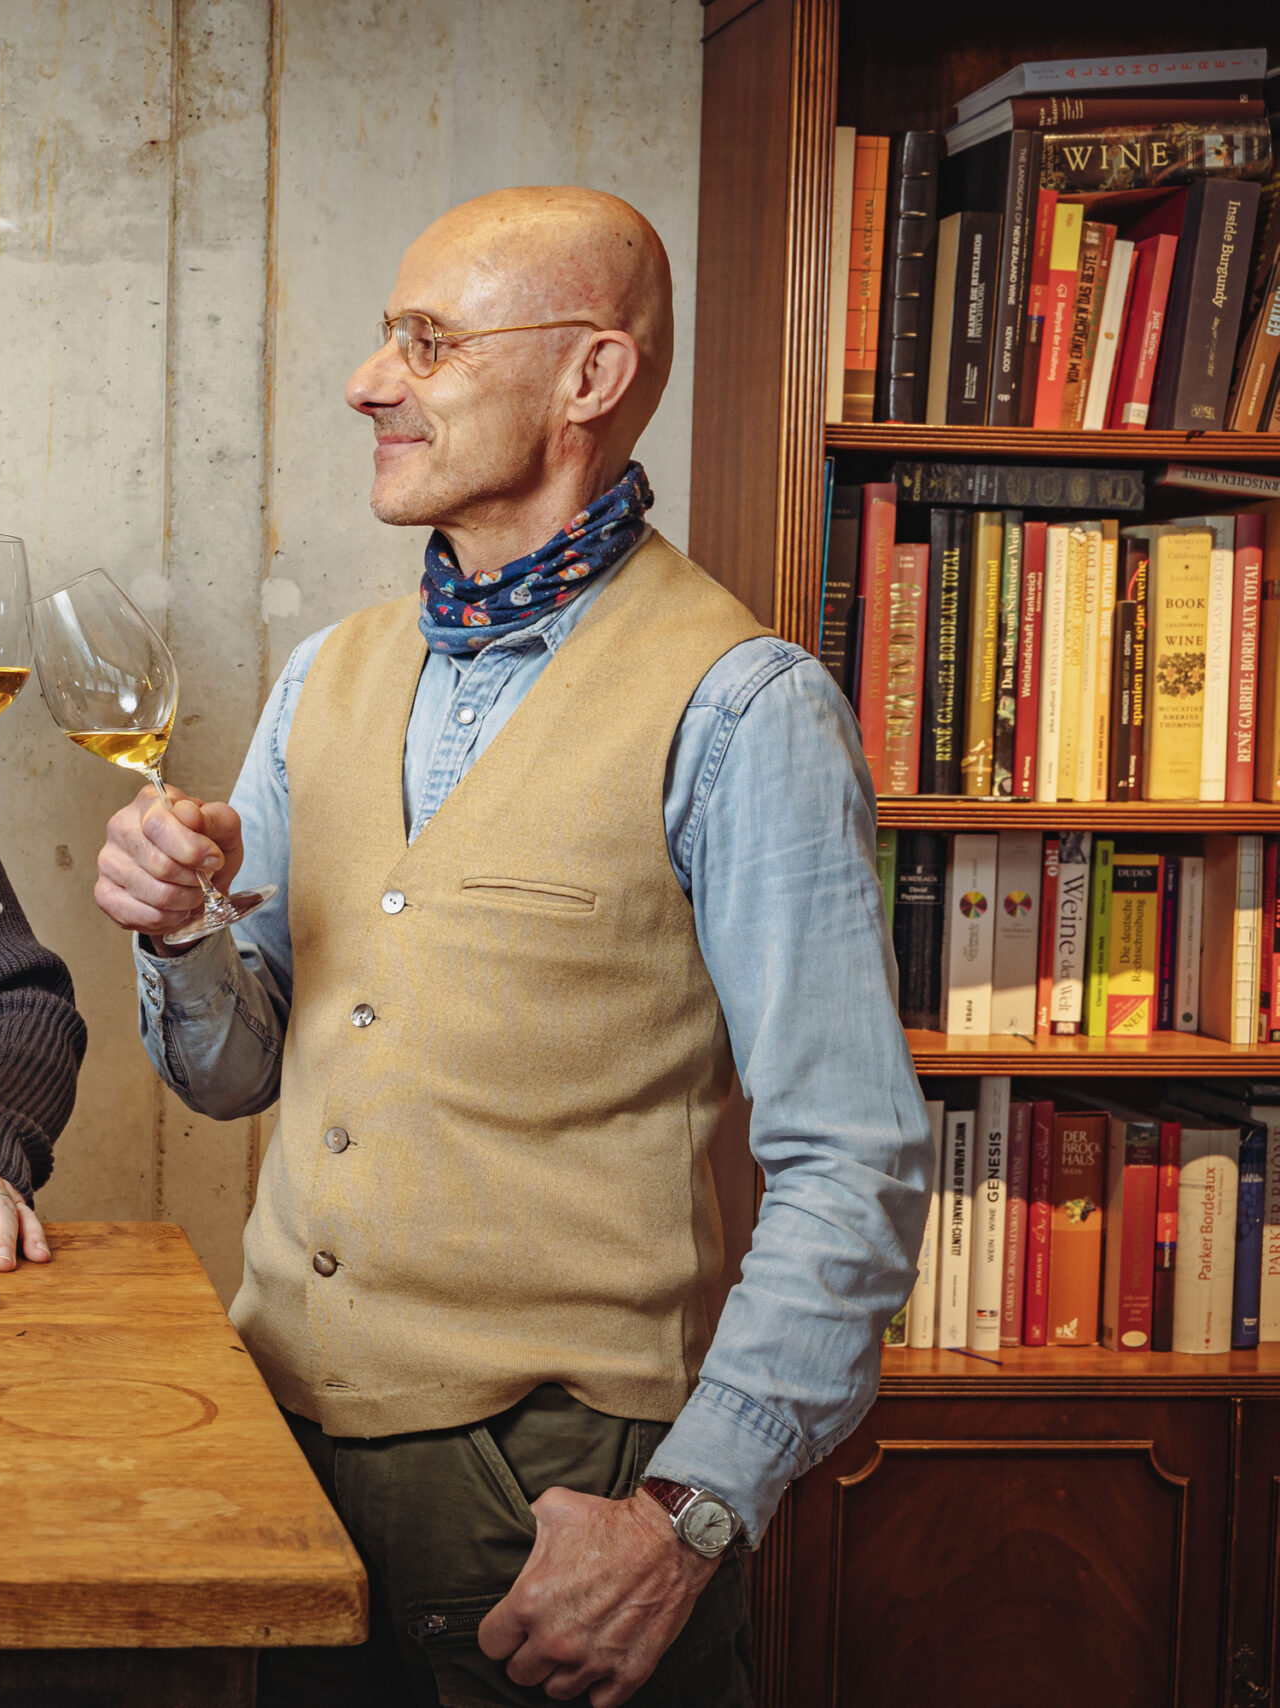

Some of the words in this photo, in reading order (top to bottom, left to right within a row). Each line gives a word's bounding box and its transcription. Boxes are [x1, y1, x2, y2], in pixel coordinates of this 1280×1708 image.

[1065, 60, 1242, 79] ALKOHOLFREI
[1020, 148, 1028, 164] THE
[1062, 142, 1170, 171] WINE
[1017, 165, 1027, 213] LANDSCAPE
[863, 199, 875, 253] KITCHEN
[1013, 226, 1022, 244] NEW
[1223, 200, 1241, 241] Inside
[971, 234, 983, 285] RETALHOS
[1010, 246, 1020, 283] ZEALAND
[1083, 253, 1098, 283] BESTE
[1212, 244, 1234, 309] Burgundy
[970, 287, 979, 301] DE
[1008, 284, 1017, 305] WINE
[1082, 284, 1092, 306] DAS
[967, 302, 978, 337] MANTA
[1054, 302, 1066, 332] Biophysik
[1071, 307, 1089, 361] EINFACHEN
[1005, 326, 1014, 349] KEVIN
[1053, 334, 1061, 345] der
[1003, 351, 1012, 373] JUDD
[1047, 346, 1061, 382] Ernährung
[1067, 362, 1079, 383] VOM
[1181, 468, 1219, 483] WEINE
[876, 527, 889, 575] WEINE
[1008, 527, 1020, 555] Wein
[942, 547, 960, 588] TOTAL
[1055, 540, 1064, 585] SPANIEN
[1101, 544, 1115, 607] AUSTRALIAN
[984, 559, 998, 639] Deutschland
[1006, 558, 1018, 612] Schweizer
[1025, 571, 1036, 621] Frankreich
[1137, 560, 1147, 603] weine
[1244, 563, 1259, 604] TOTAL
[872, 579, 885, 632] GROSSE
[1165, 598, 1206, 609] BOOK
[887, 582, 923, 690] CALIFORNIA
[939, 592, 957, 662] BORDEAUX
[1006, 613, 1015, 637] vom
[1049, 590, 1062, 688] WEINLANDSCHAFT
[1100, 609, 1113, 636] WINE
[1135, 604, 1145, 641] seine
[1241, 606, 1257, 672] BORDEAUX
[1003, 638, 1014, 667] Buch
[1135, 644, 1144, 671] und
[1165, 636, 1204, 646] WINE
[1211, 604, 1224, 682] WEINATLAS
[869, 637, 882, 699] ITALIENS
[980, 641, 994, 703] Weinatlas
[1001, 668, 1013, 689] Das
[1021, 624, 1034, 698] Weinlandschaft
[1132, 674, 1144, 727] spanien
[1238, 673, 1254, 729] GABRIEL:
[932, 728, 952, 762] RENÉ
[1233, 732, 1252, 763] RENÉ
[1046, 850, 1059, 877] oh!
[1118, 869, 1152, 877] DUDEN
[1059, 874, 1085, 955] Weine
[1121, 898, 1133, 943] deutsche
[1120, 946, 1130, 964] Die
[1131, 898, 1146, 982] Rechtschreibung
[1060, 959, 1075, 979] der
[1058, 984, 1073, 1011] Welt
[1123, 1008, 1145, 1032] NEU
[956, 1122, 967, 1148] WHO'S
[1063, 1131, 1087, 1142] DER
[1063, 1142, 1101, 1153] BROCK
[954, 1149, 966, 1176] AFRAID
[987, 1131, 1002, 1203] GENESIS
[1062, 1153, 1095, 1165] HAUS
[954, 1177, 964, 1187] OF
[1200, 1168, 1217, 1235] Bordeaux
[988, 1208, 996, 1232] WINE
[1010, 1205, 1019, 1243] LEXIKON
[987, 1239, 995, 1263] WEIN
[1268, 1203, 1280, 1276] PARKER
[1007, 1245, 1017, 1282] GROSSES
[1198, 1238, 1212, 1282] Parker
[1005, 1284, 1015, 1322] CLARKE'S
